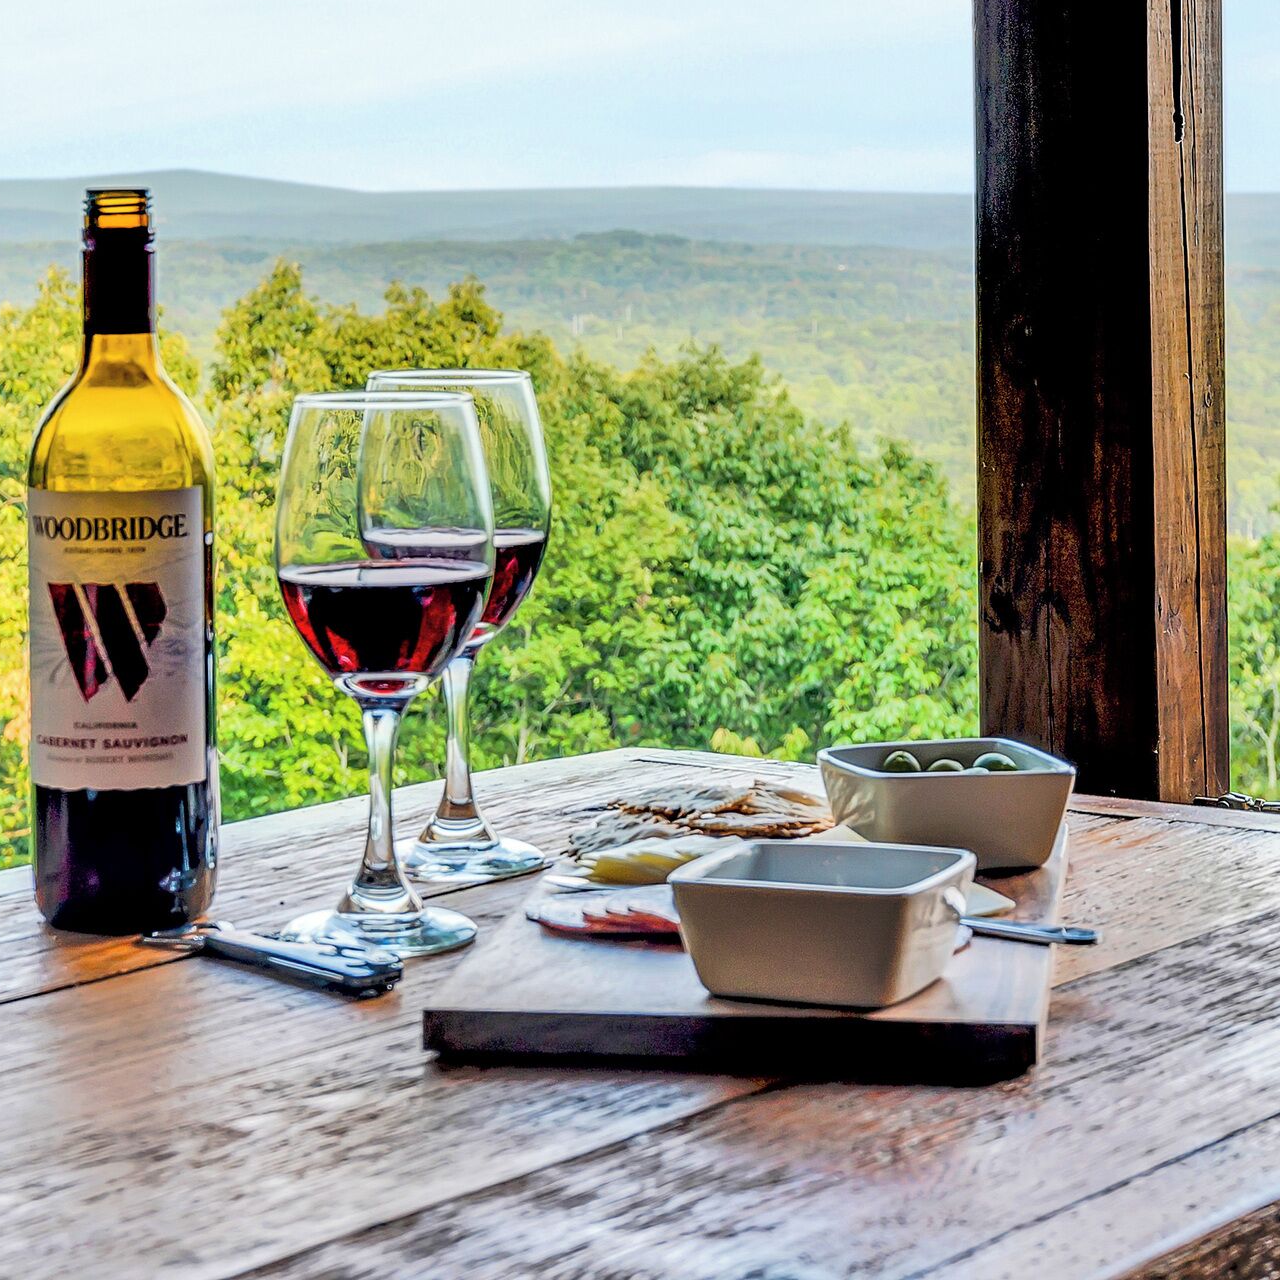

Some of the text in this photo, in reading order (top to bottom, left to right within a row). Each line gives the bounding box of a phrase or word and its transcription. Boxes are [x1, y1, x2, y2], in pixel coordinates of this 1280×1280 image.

[32, 514, 188, 541] WOODBRIDGE
[36, 733, 189, 750] CABERNET SAUVIGNON
